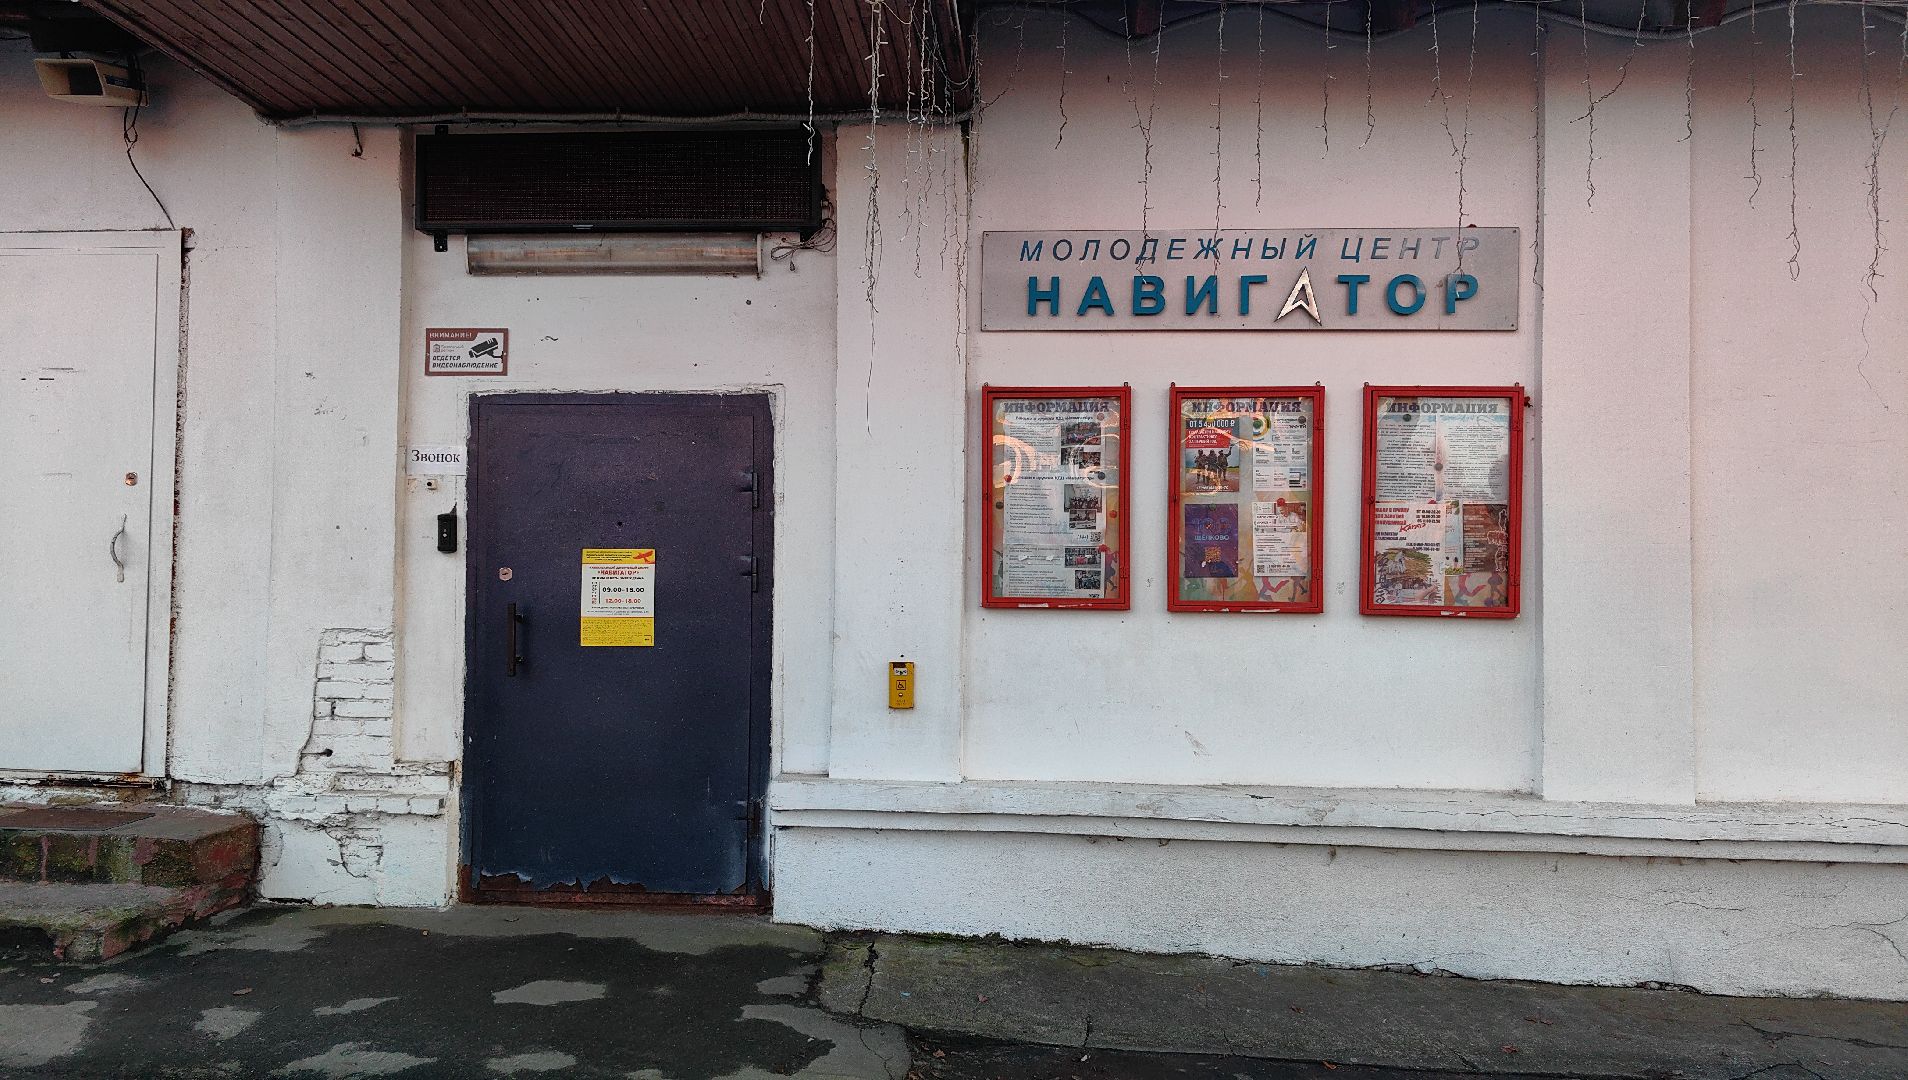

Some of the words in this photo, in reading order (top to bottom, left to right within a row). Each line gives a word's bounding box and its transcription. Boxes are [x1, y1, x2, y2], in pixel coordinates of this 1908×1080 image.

[1019, 234, 1318, 263] МОЛОДЕЖНЫЙ
[1340, 235, 1482, 263] ЦЕНТР
[1026, 267, 1481, 327] НАВИГАТОР
[1003, 401, 1111, 414] ИНФОРМАЦИЯ
[1191, 401, 1303, 413] ИНФОРМАЦИЯ
[1386, 402, 1499, 414] ИНФОРМАЦИЯ
[411, 449, 461, 463] Звонок
